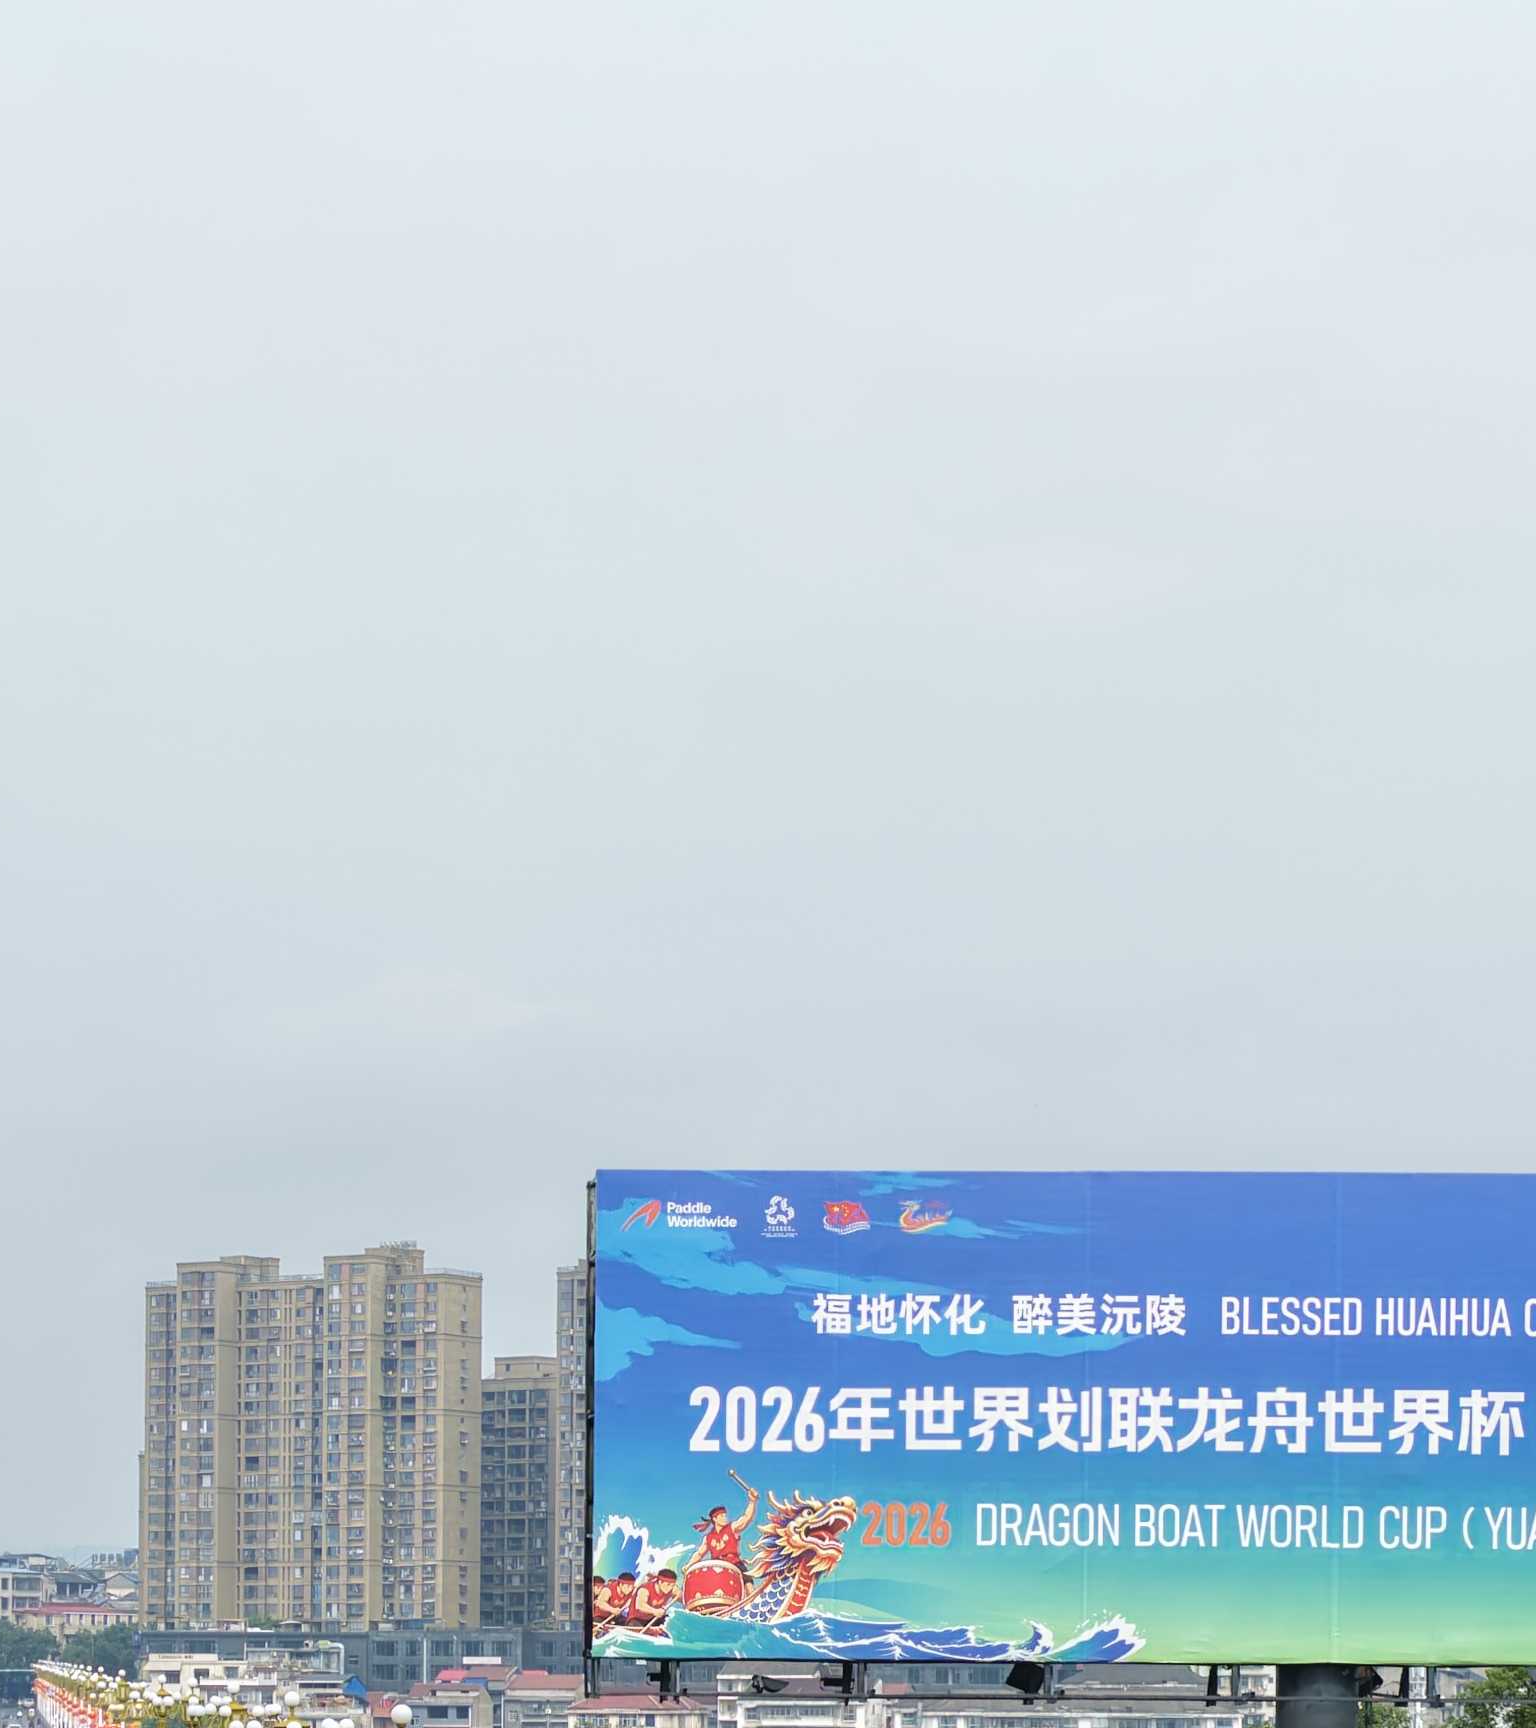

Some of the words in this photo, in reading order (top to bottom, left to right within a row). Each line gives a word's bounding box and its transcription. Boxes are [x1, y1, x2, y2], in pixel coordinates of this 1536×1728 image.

[667, 1202, 712, 1214] Paddle
[667, 1215, 738, 1228] Worldwide
[811, 1293, 986, 1335] 福地怀化
[1012, 1293, 1187, 1336] 醉美沅陵
[1221, 1296, 1363, 1336] BLESSED
[1375, 1297, 1512, 1338] HUAIHUA
[862, 1501, 953, 1547] 2026
[976, 1503, 1121, 1547] DRAGON
[1134, 1504, 1226, 1548] BOAT
[1236, 1504, 1364, 1549] WORLD
[1378, 1506, 1446, 1550] CUP
